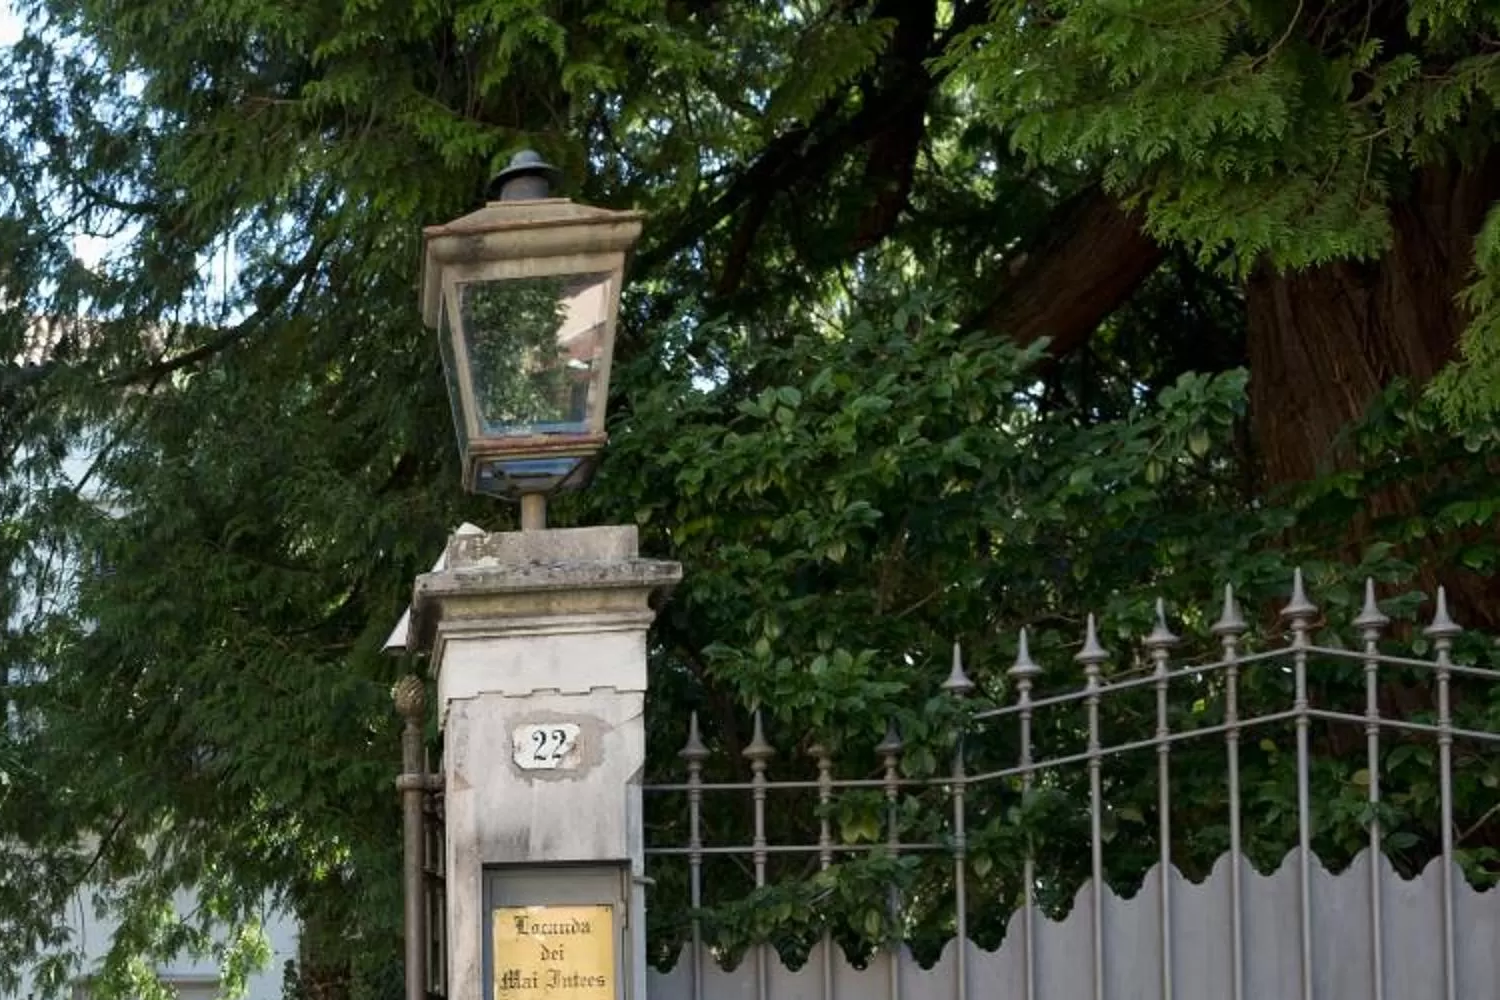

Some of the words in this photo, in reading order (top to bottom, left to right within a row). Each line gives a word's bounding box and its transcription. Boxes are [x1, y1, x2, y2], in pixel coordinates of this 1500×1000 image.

[531, 729, 567, 761] 22
[513, 914, 591, 935] Locanda
[539, 943, 565, 961] dei
[499, 969, 539, 990] Mai
